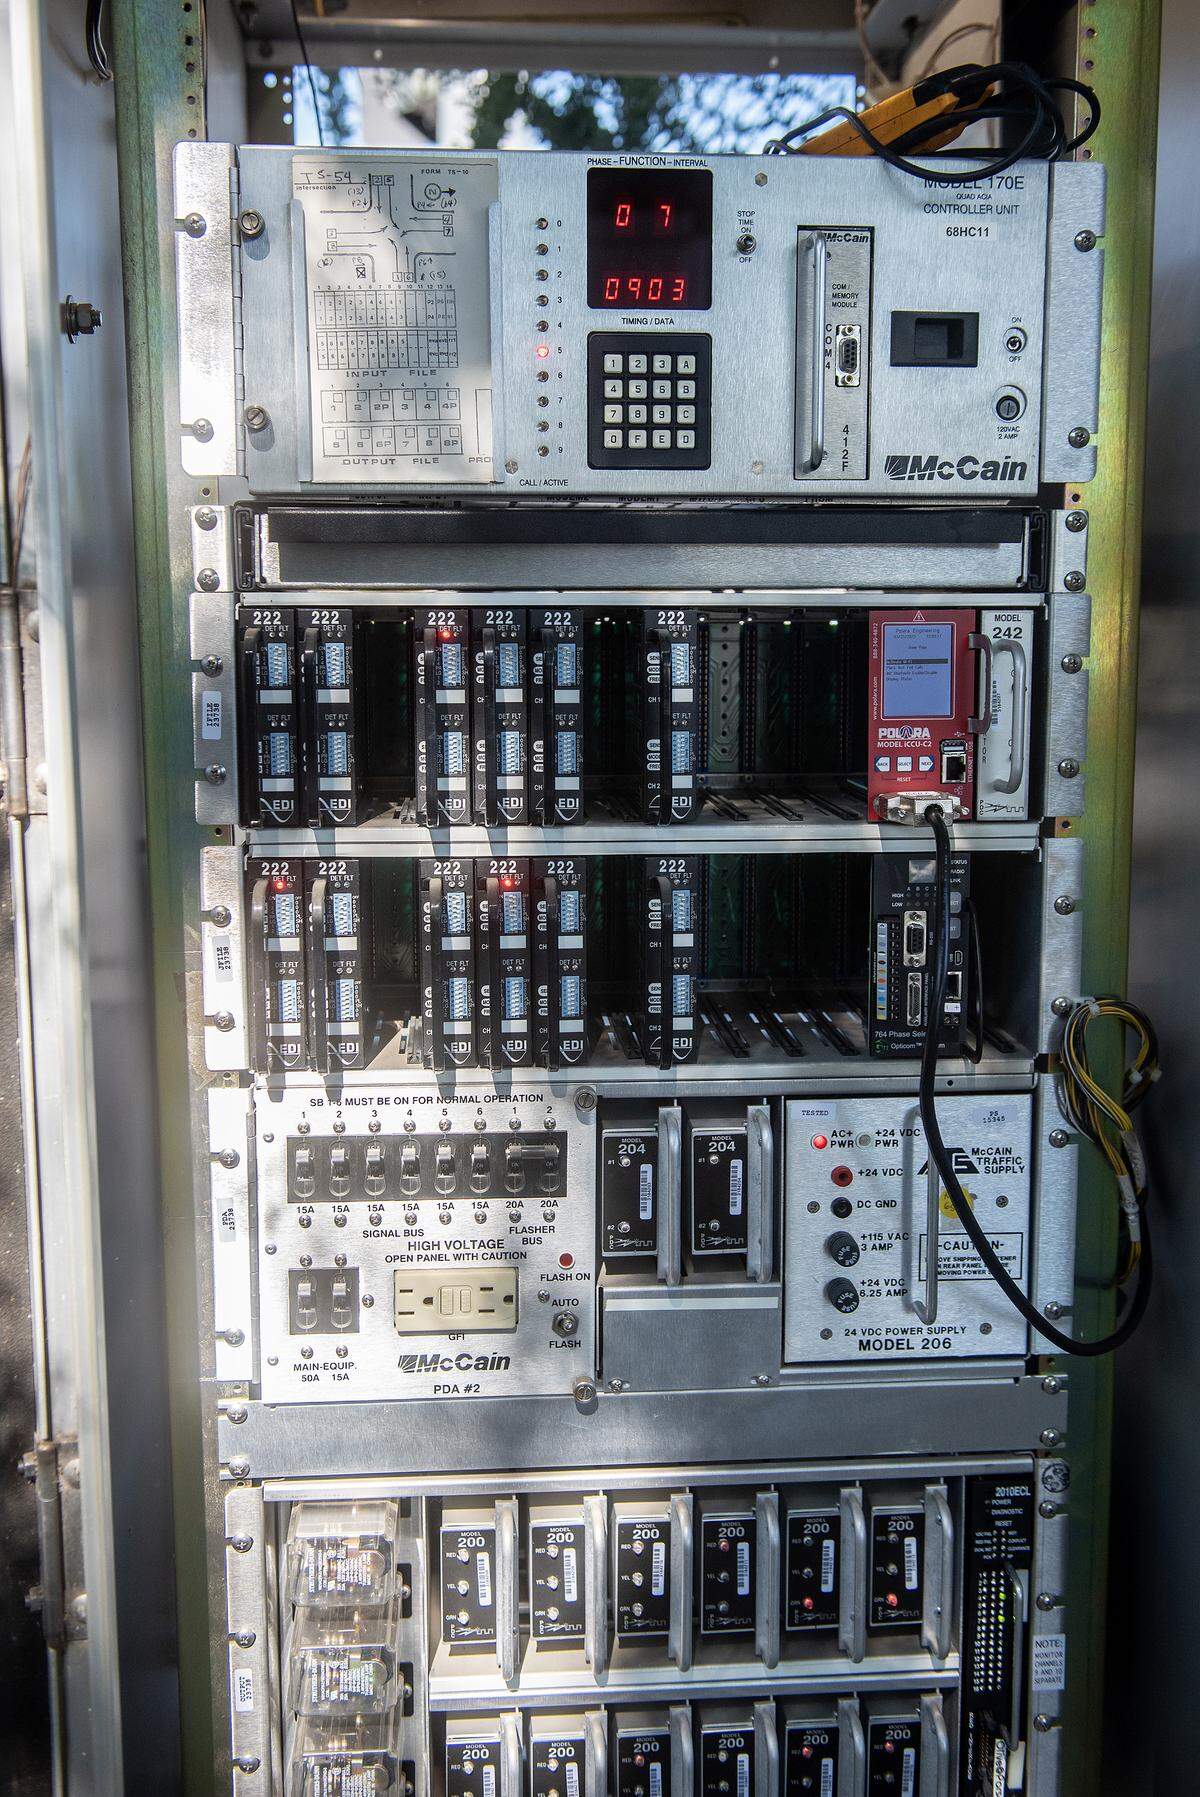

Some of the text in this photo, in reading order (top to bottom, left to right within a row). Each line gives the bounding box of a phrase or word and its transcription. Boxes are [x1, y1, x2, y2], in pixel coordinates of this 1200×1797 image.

[924, 176, 1024, 189] MODEL 170E
[924, 204, 1019, 214] CONTROLLER UNIT
[616, 205, 671, 227] 0 7
[946, 227, 989, 237] 68HC11
[827, 234, 868, 242] McCain
[908, 455, 1027, 481] McCain
[253, 612, 281, 624] 222
[428, 612, 455, 625] 222
[658, 612, 684, 624] 222
[993, 627, 1023, 639] 242
[879, 727, 930, 738] POLARA
[273, 800, 294, 809] EDI
[672, 797, 692, 806] EDI
[262, 863, 289, 875] 222
[434, 862, 460, 874] 222
[659, 860, 685, 872] 222
[451, 1042, 471, 1051] EDI
[345, 1097, 373, 1106] MUST
[378, 1097, 391, 1105] BE
[394, 1097, 410, 1105] ON
[414, 1096, 433, 1105] FOR
[437, 1095, 480, 1104] NORMAL
[484, 1094, 543, 1103] OPERATION
[618, 1144, 646, 1154] 204
[709, 1142, 735, 1152] 204
[297, 1206, 314, 1214] 15A
[332, 1205, 349, 1213] 15A
[367, 1205, 384, 1213] 15A
[506, 1201, 524, 1209] 20A
[540, 1200, 558, 1208] 20A
[509, 1226, 555, 1235] FLASHER
[408, 1240, 504, 1250] HIGH VOLTAGE
[385, 1252, 527, 1262] OPEN PANEL WITH CAUTION
[552, 1299, 578, 1307] AUTO
[859, 1338, 951, 1351] MODEL 206
[294, 1362, 357, 1371] MAIN-EQUIP.
[416, 1352, 510, 1373] McCain
[434, 1384, 480, 1394] PDA #2
[996, 1487, 1030, 1496] 2010ECL
[804, 1523, 830, 1533] 200
[633, 1529, 659, 1539] 200
[458, 1537, 484, 1547] 200
[1035, 1639, 1062, 1648] NOTE:
[885, 1730, 911, 1739] 200
[634, 1742, 659, 1752] 200
[463, 1749, 489, 1759] 200
